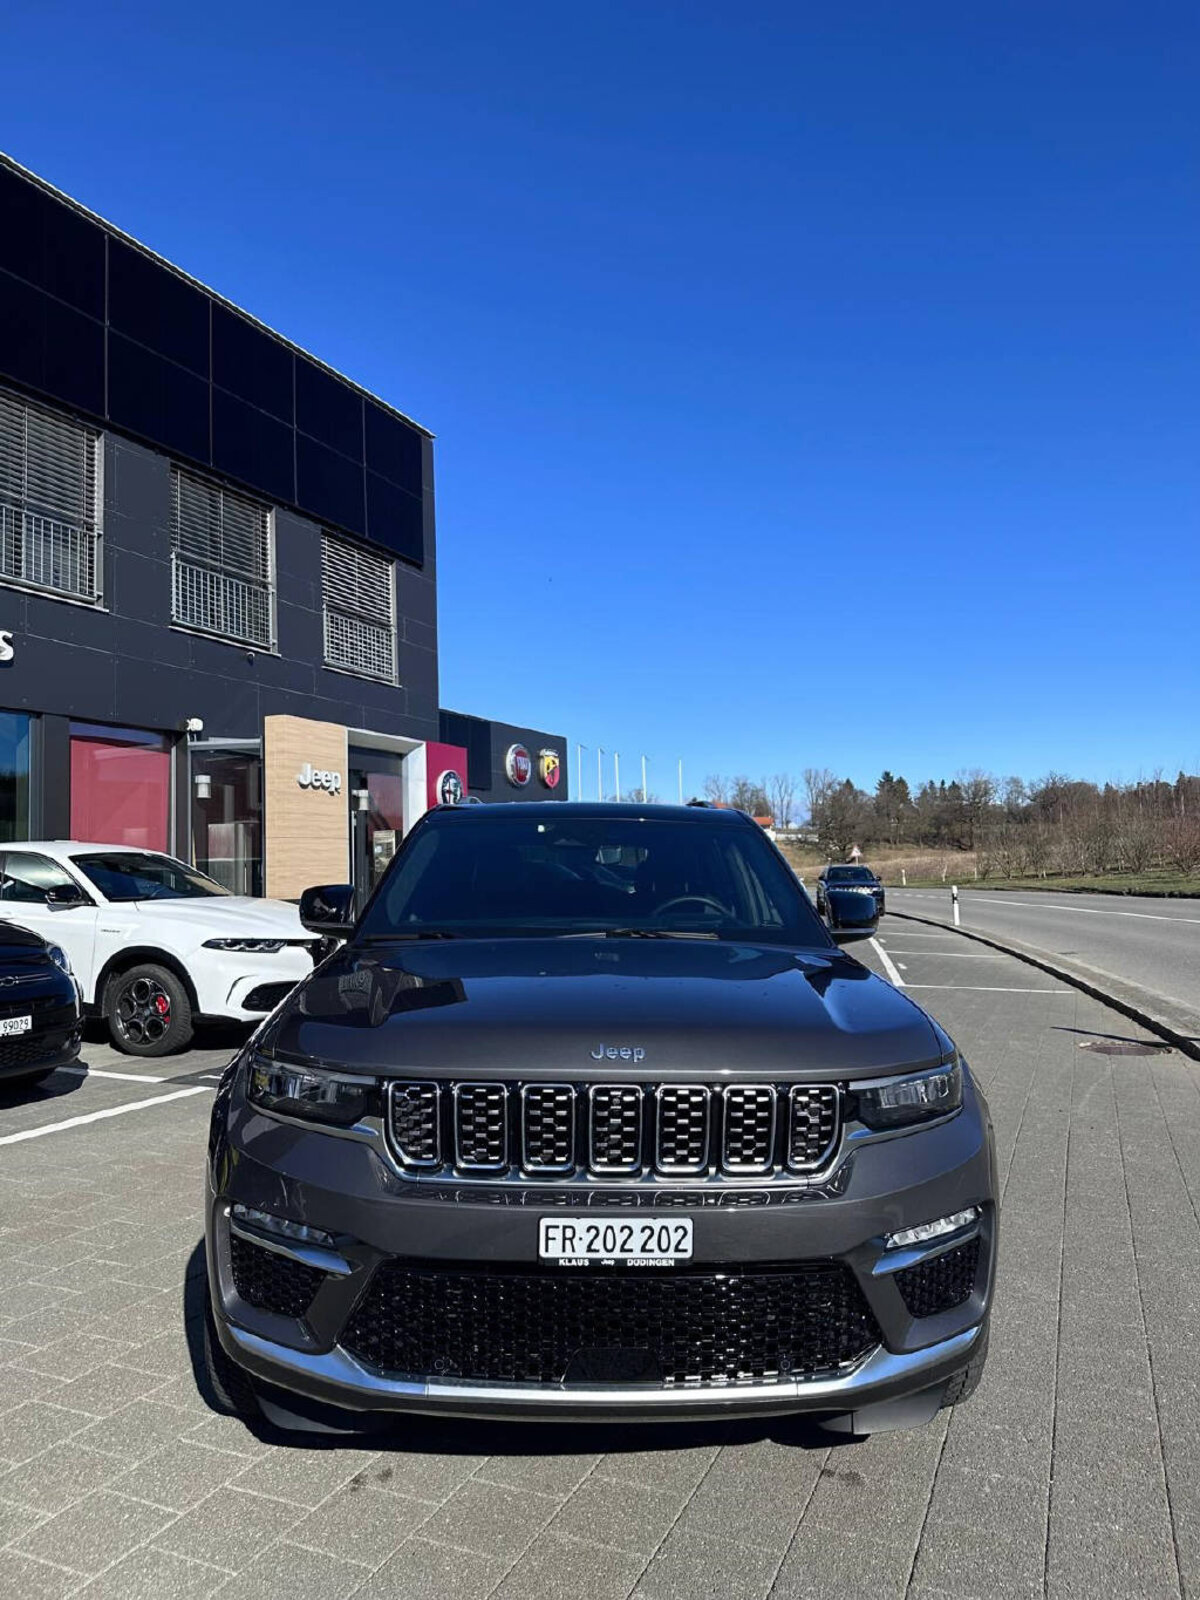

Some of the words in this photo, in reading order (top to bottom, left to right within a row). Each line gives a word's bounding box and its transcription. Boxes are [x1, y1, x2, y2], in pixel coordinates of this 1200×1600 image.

[297, 762, 342, 793] Jeep
[590, 1043, 646, 1063] Jeep
[558, 1258, 590, 1267] KLAUS
